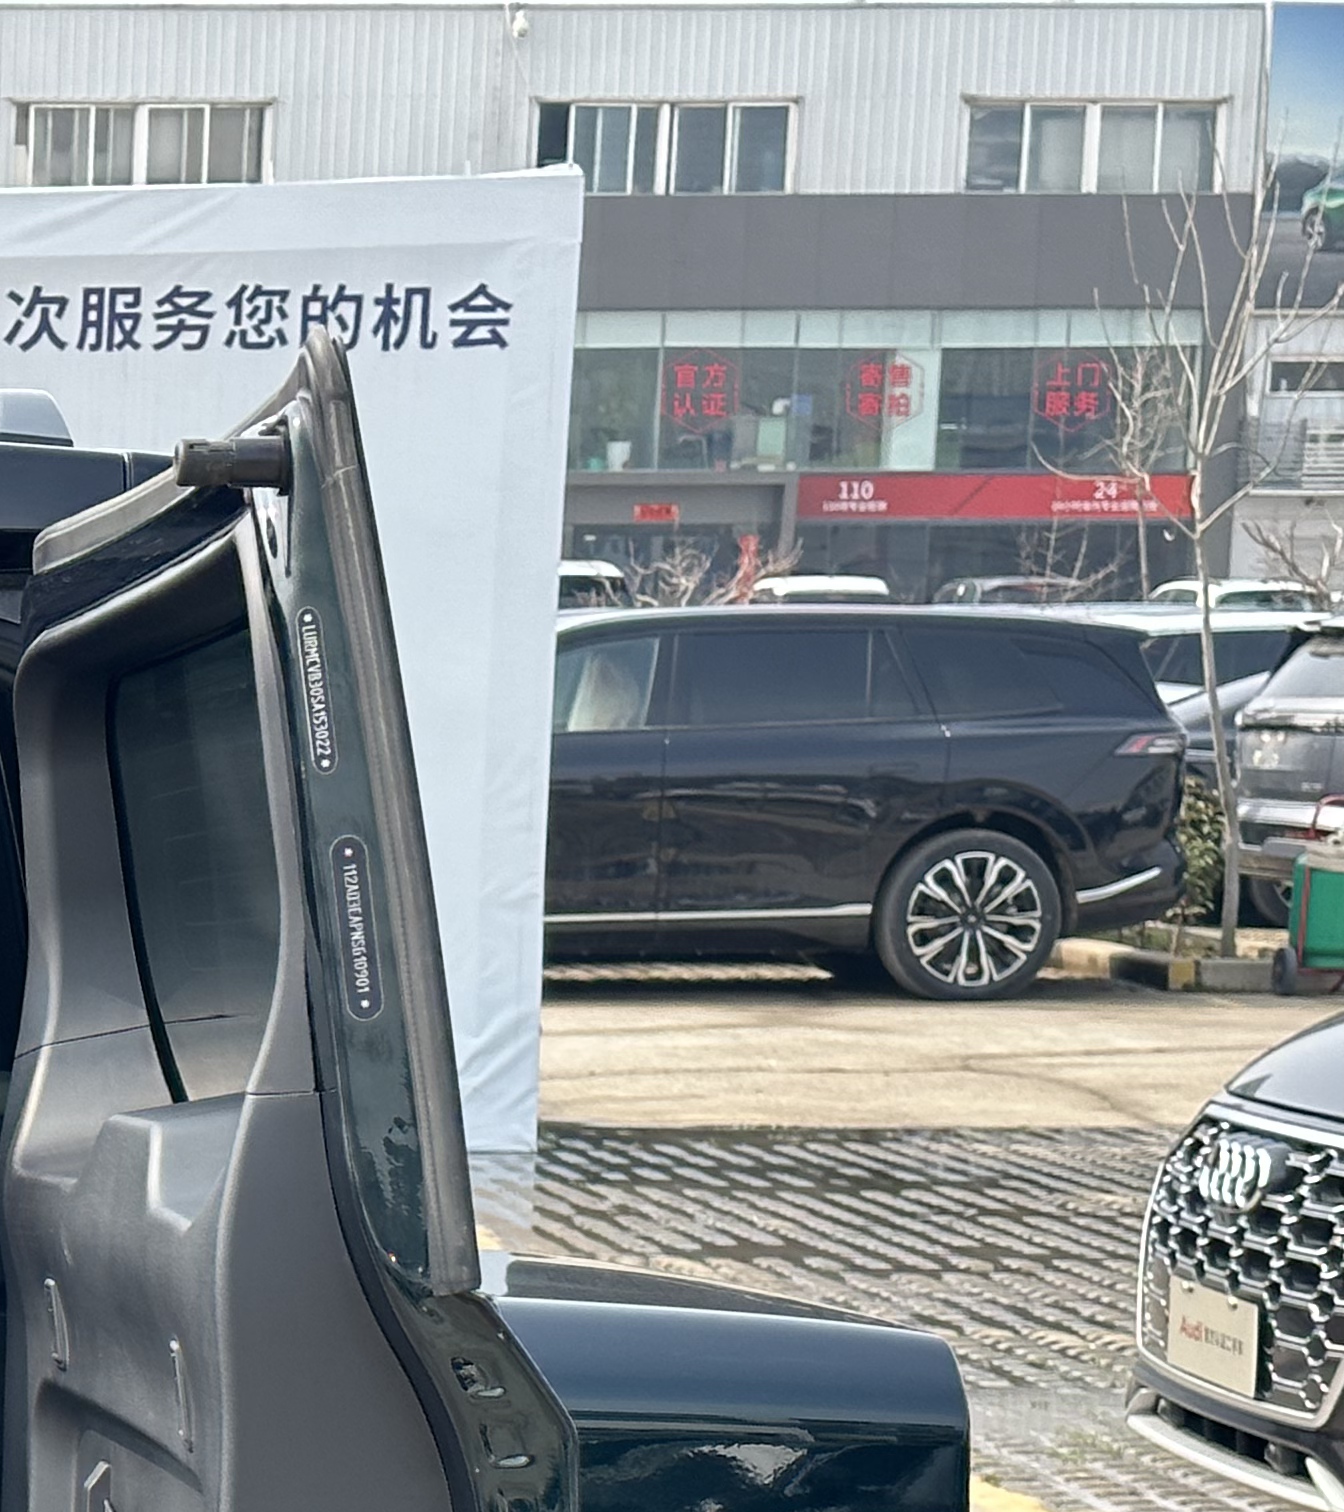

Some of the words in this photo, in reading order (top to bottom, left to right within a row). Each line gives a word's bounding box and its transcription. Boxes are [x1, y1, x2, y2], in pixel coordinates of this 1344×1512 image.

[673, 363, 727, 388] 官方
[1045, 362, 1101, 388] 上门
[673, 392, 727, 417] 认证
[1045, 391, 1099, 419] 服务
[838, 480, 874, 500] 110
